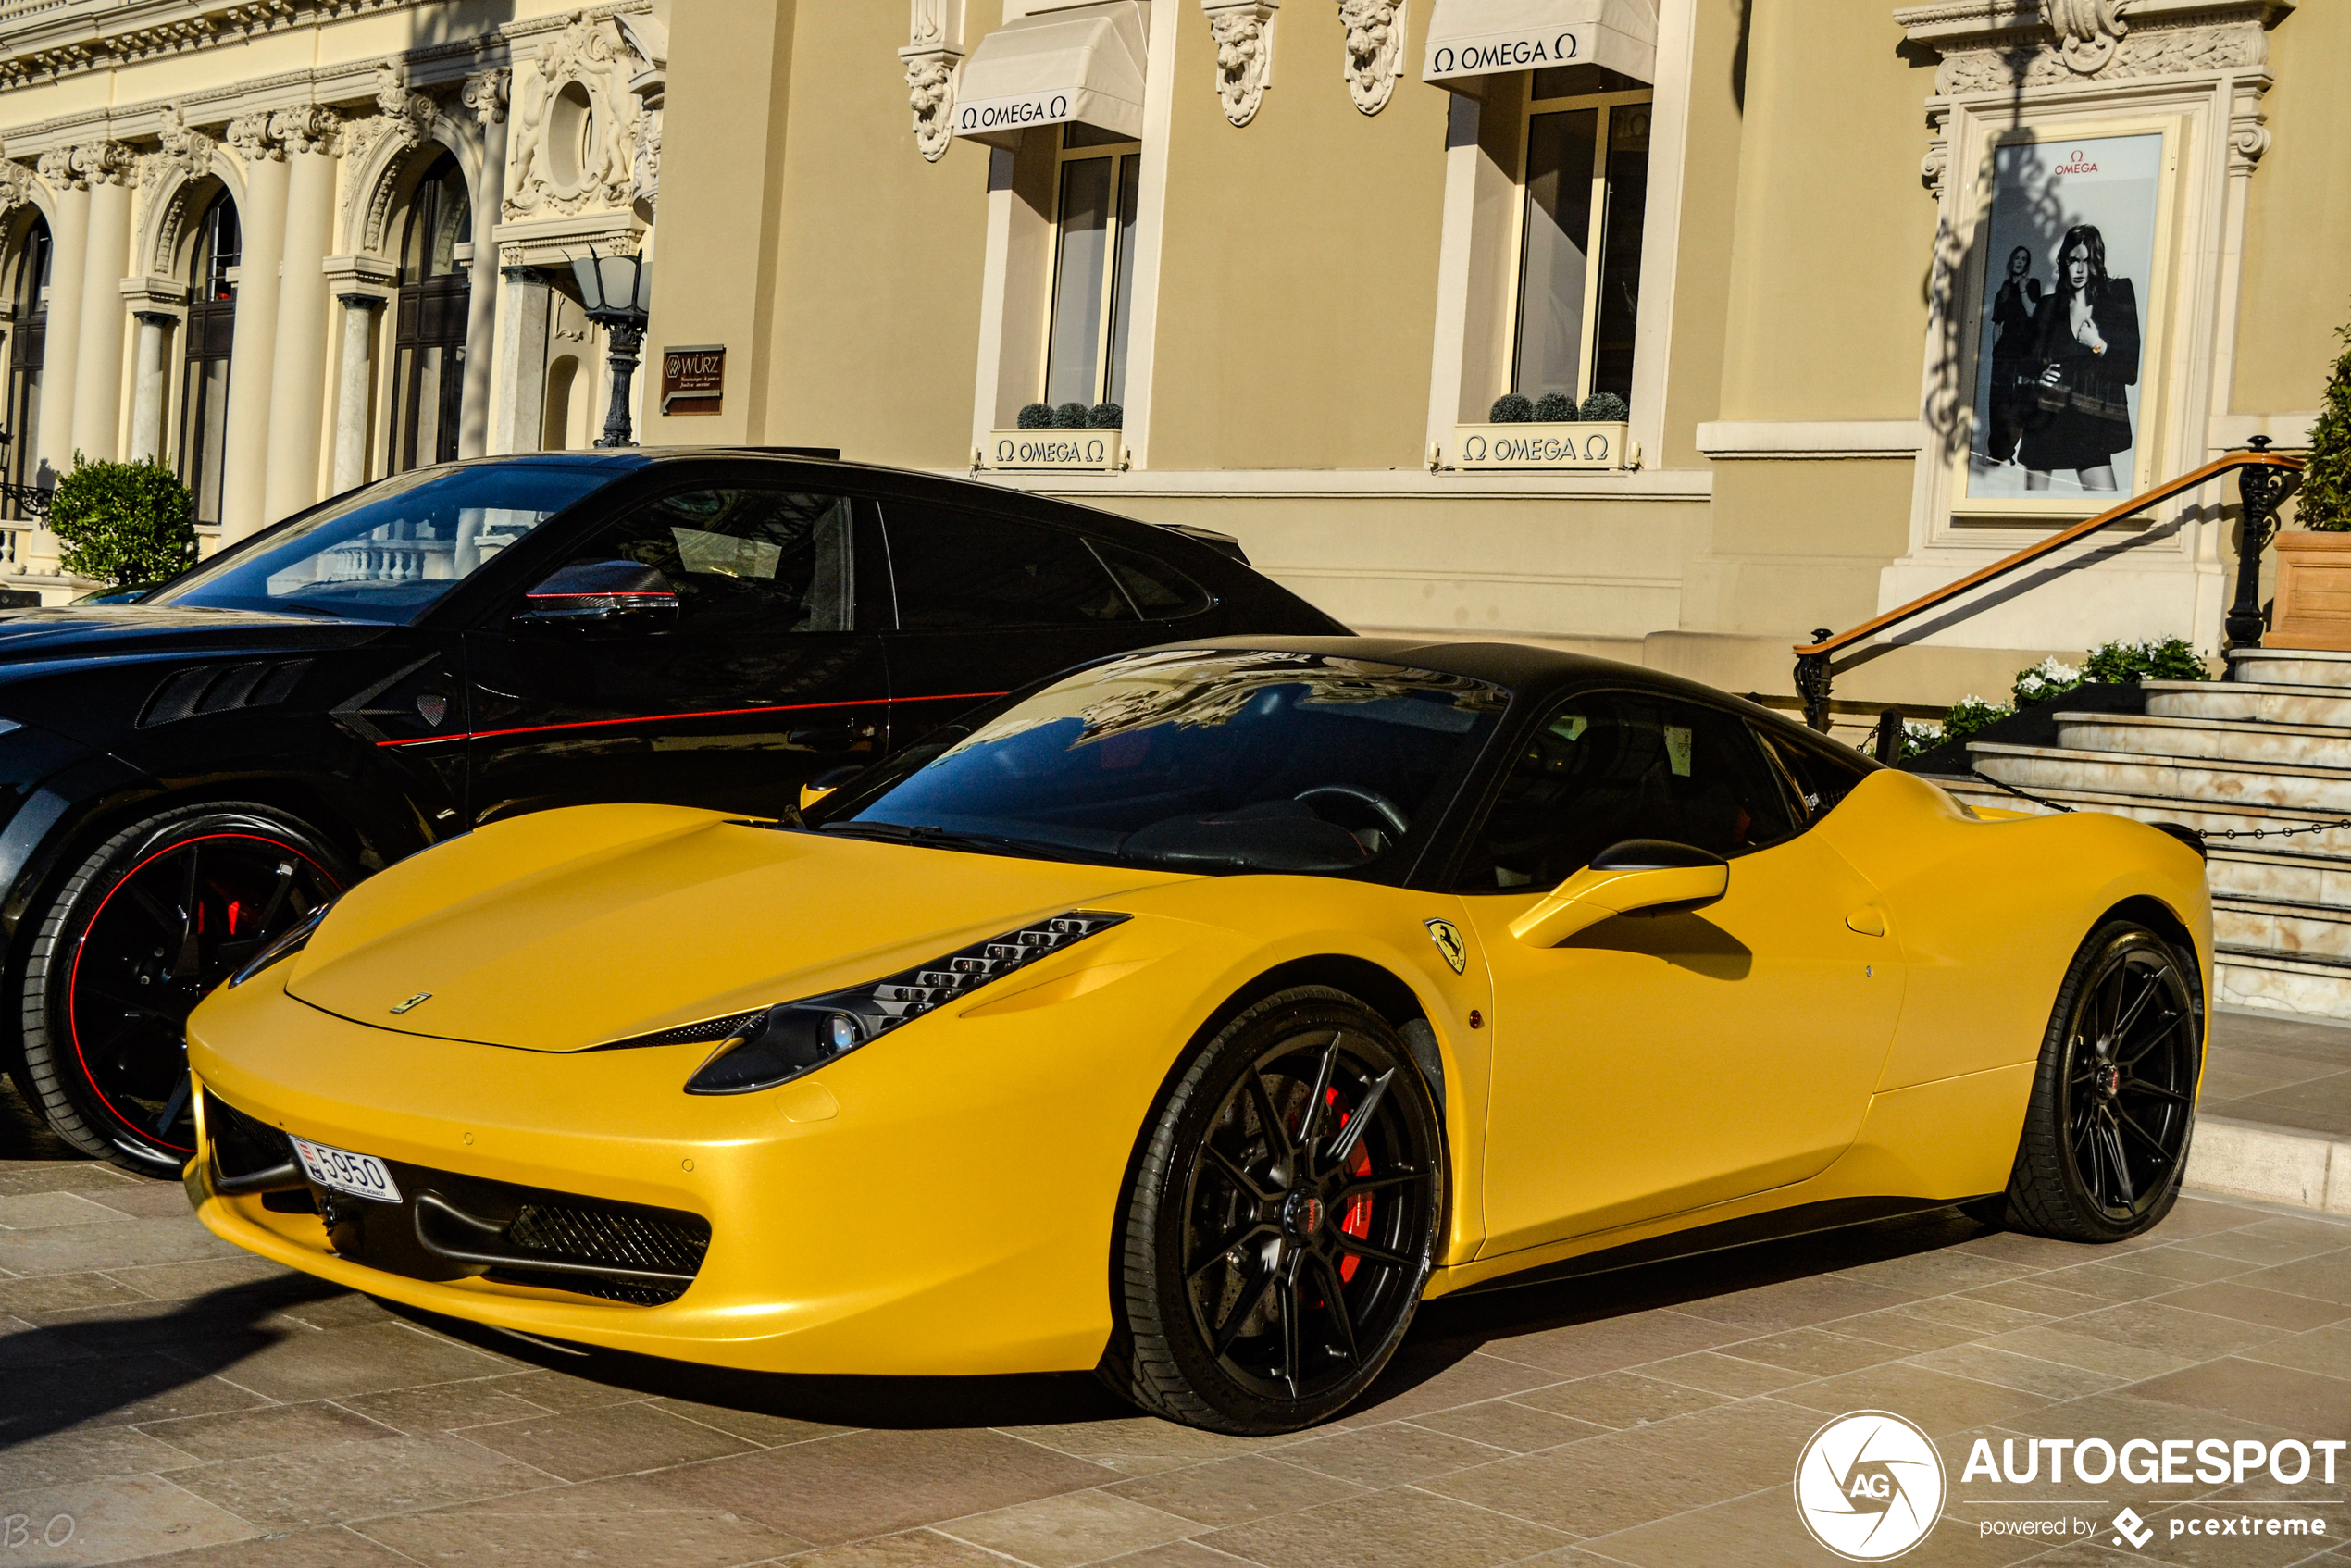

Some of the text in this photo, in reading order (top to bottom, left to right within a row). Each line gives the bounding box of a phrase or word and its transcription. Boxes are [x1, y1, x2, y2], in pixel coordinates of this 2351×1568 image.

[1461, 40, 1548, 70] OMEGA
[982, 102, 1045, 127] OMEGA
[2054, 162, 2098, 176] OMEGA
[681, 353, 719, 374] WÜRZ
[1019, 442, 1081, 463] OMEGA
[1493, 437, 1577, 462] OMEGA
[316, 1148, 386, 1189] 5950
